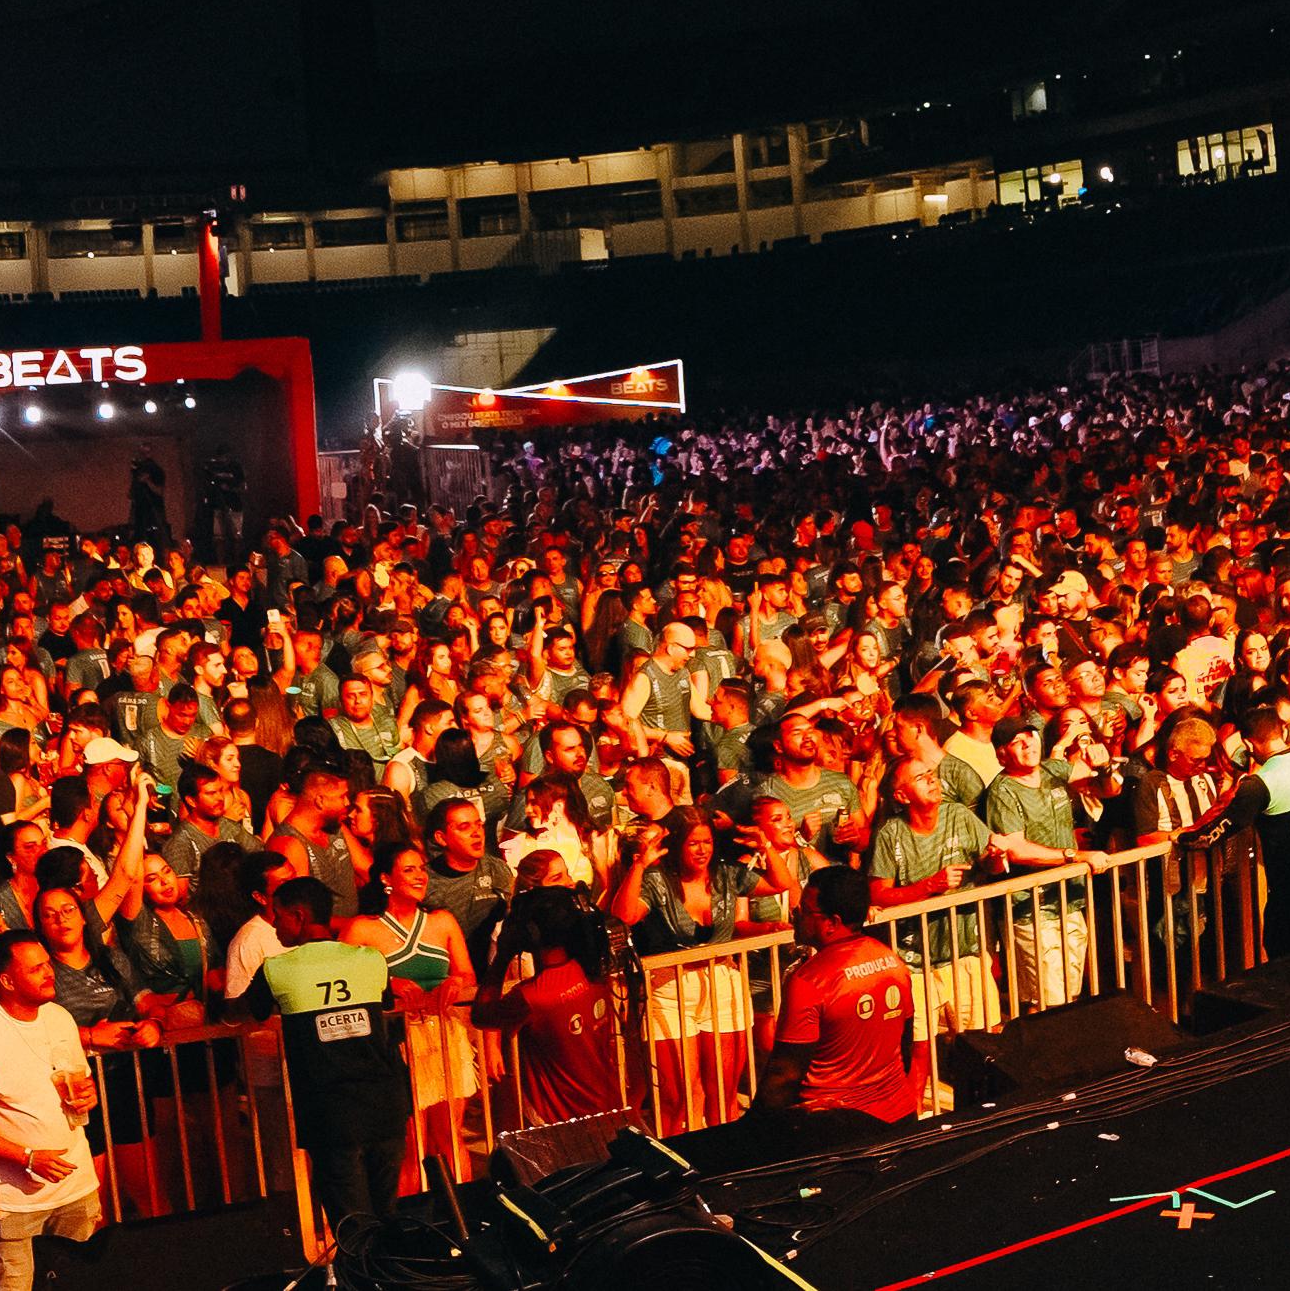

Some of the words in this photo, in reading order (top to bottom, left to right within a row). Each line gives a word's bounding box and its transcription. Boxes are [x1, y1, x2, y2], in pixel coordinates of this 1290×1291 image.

[610, 378, 669, 396] BEATS
[316, 979, 352, 1005] 73
[327, 1013, 366, 1027] CERTA
